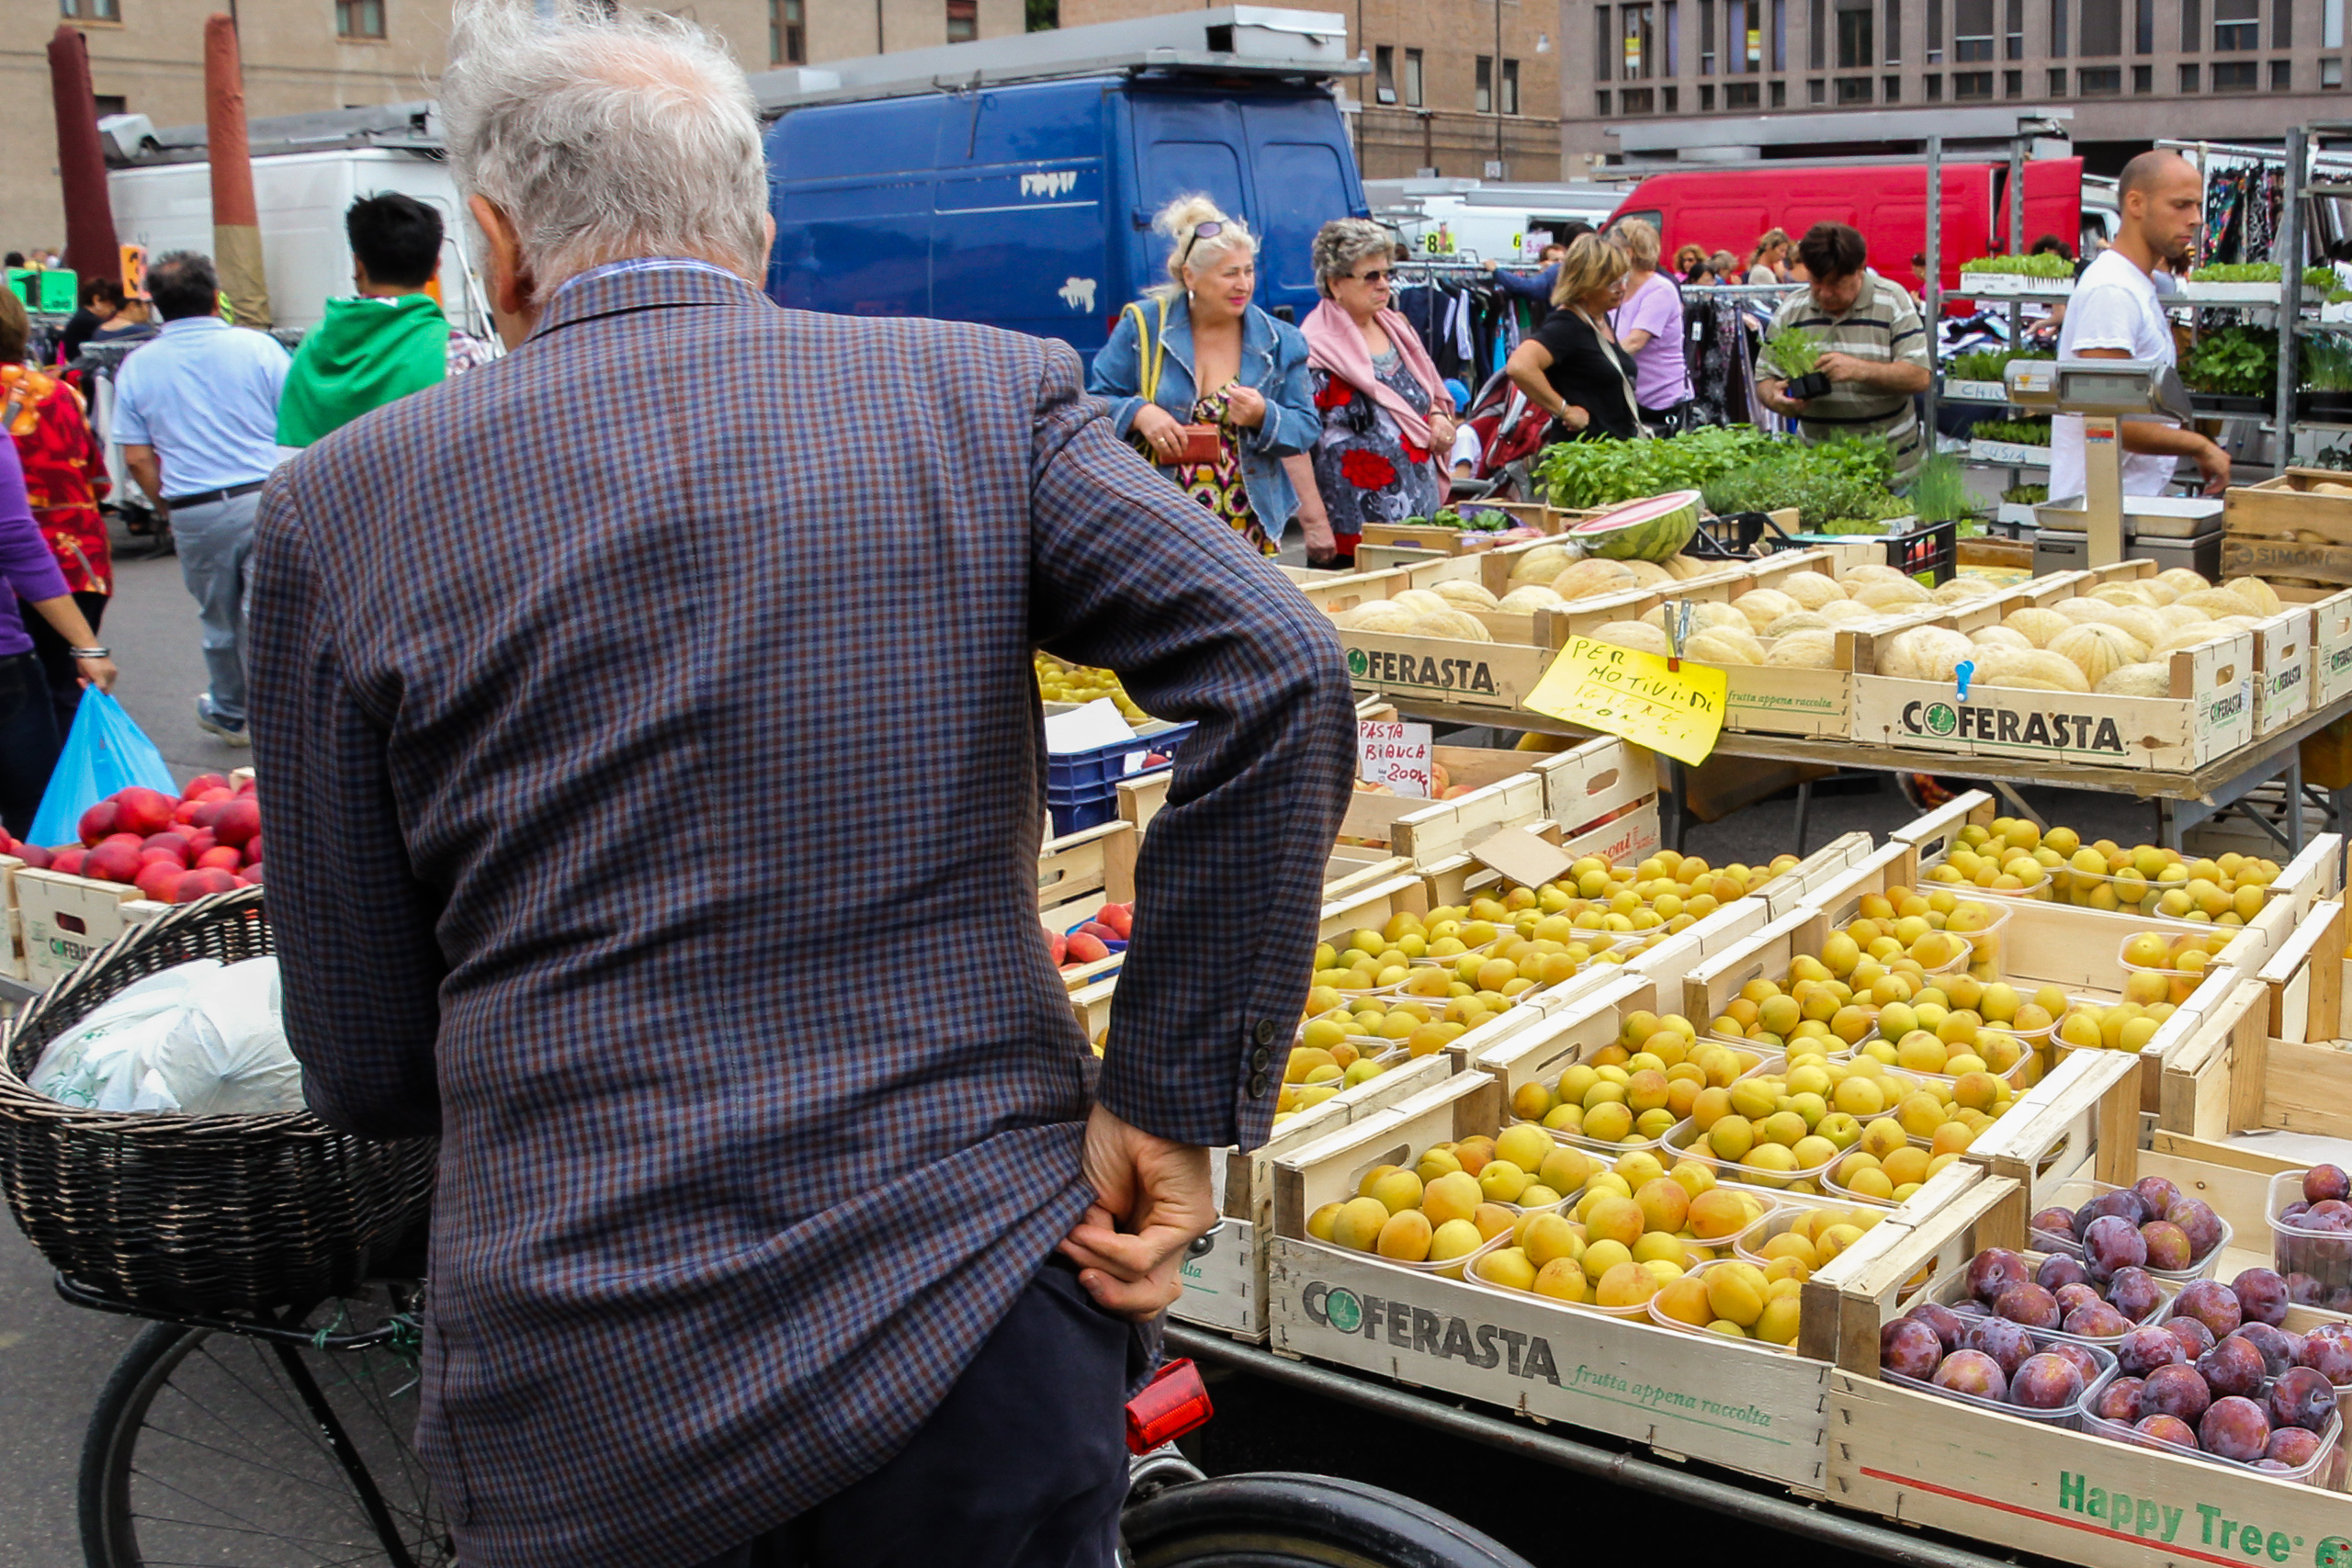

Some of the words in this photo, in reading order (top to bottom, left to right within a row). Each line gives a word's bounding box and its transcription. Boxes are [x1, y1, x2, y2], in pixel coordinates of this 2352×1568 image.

[1572, 640, 1624, 665] PER
[1726, 690, 1757, 703] frutta
[1758, 694, 1792, 706] appena
[1795, 697, 1832, 708] raccolta
[1360, 721, 1404, 740] PASTA
[1903, 700, 2124, 751] COFERASTA
[1303, 1280, 1561, 1387] COFERASTA
[1570, 1364, 1627, 1392] frutta
[1631, 1382, 1697, 1409] appena
[1701, 1399, 1771, 1427] raccolta
[2059, 1470, 2184, 1542] Happy
